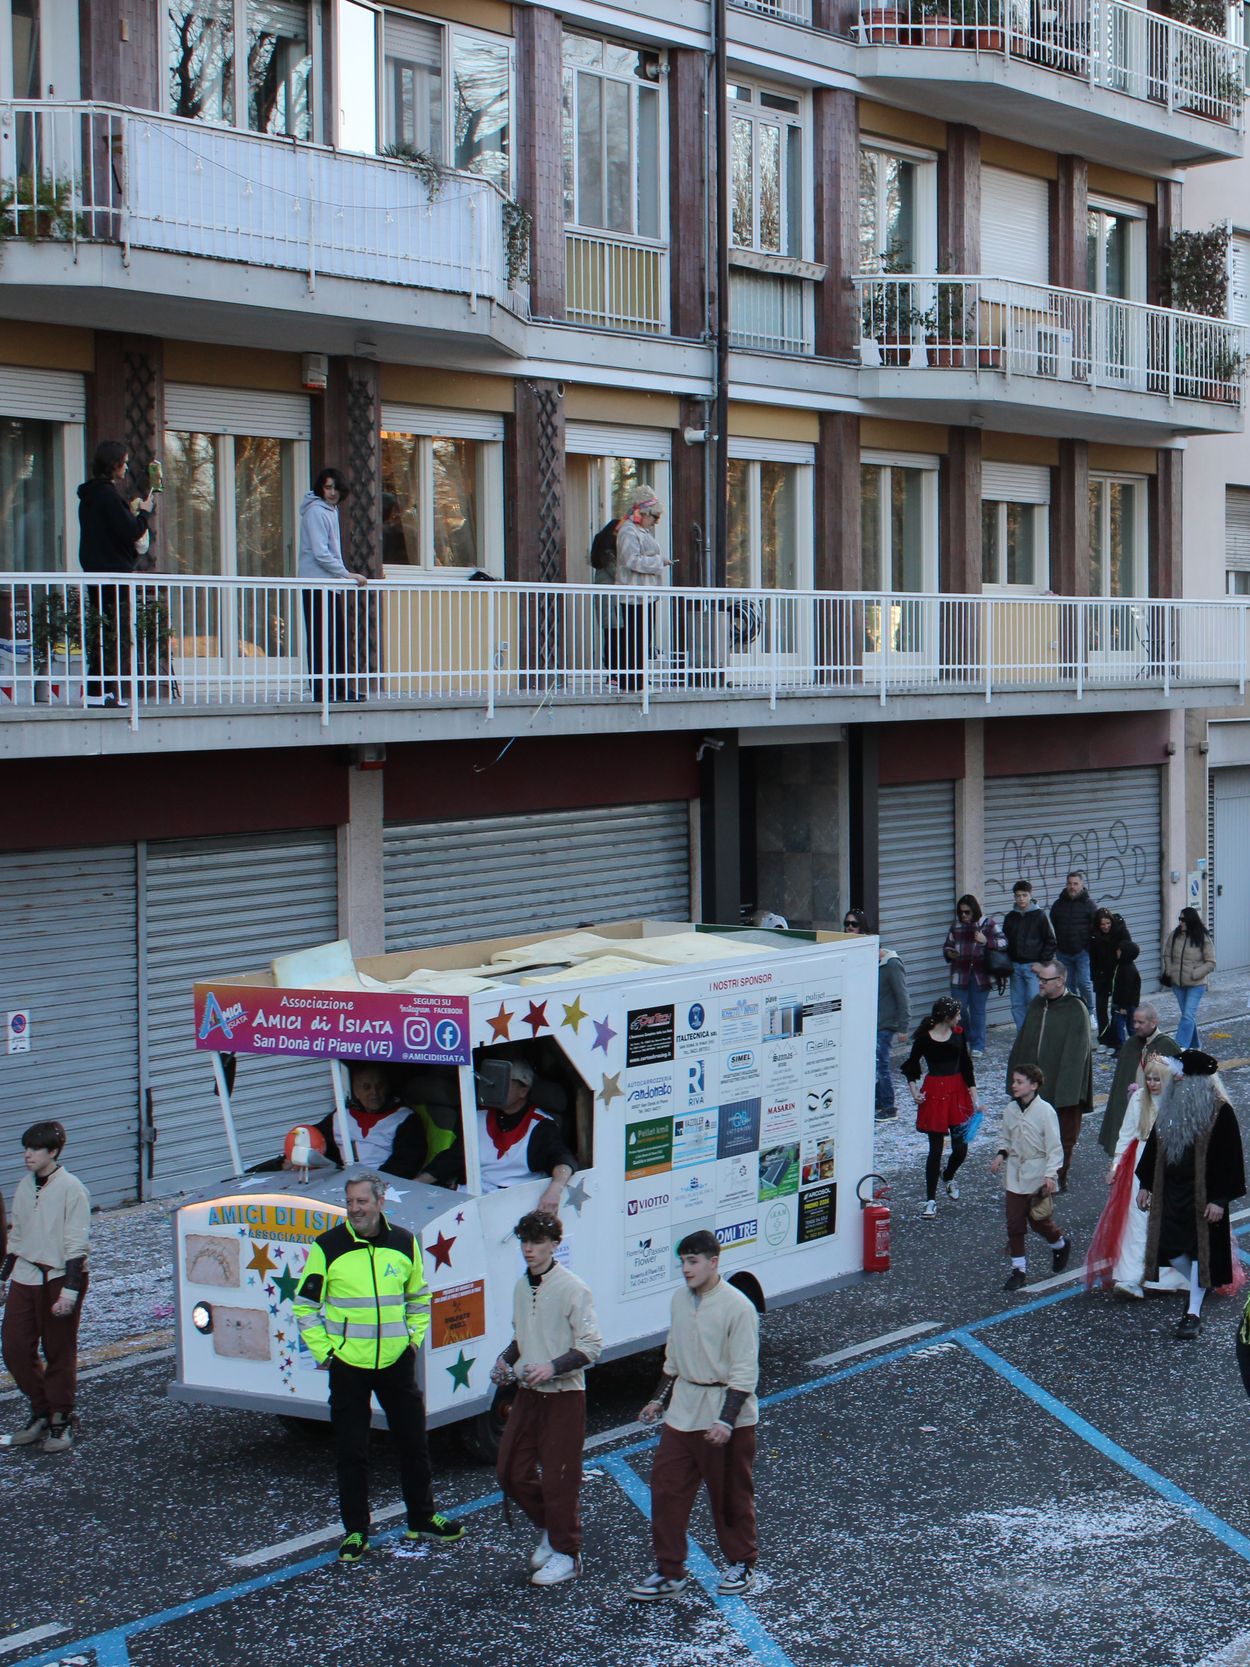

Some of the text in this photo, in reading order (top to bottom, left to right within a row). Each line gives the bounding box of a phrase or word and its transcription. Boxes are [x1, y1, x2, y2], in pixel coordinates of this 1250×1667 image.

[713, 980, 740, 991] NOSTRI
[740, 974, 773, 987] SPONSOR
[280, 996, 354, 1011] Associazione
[413, 997, 452, 1006] SEGUICI SU
[400, 1004, 464, 1016] Instagram FACEBOOK
[252, 1009, 394, 1035] AMICI di ISIATA
[676, 1031, 710, 1042] ITALTECNICA
[253, 1033, 393, 1057] San Donà di Piave (VE)
[730, 1054, 751, 1064] SIMEL
[627, 1075, 672, 1088] AUTOCARROZZERIA
[688, 1096, 704, 1106] RIVA
[767, 1102, 796, 1114] MASARIN
[638, 1126, 656, 1138] Pellet
[807, 1188, 832, 1198] ARCOSOL
[639, 1194, 670, 1209] VIOTTO
[208, 1204, 348, 1231] AMICI DI ISIA
[249, 1229, 317, 1244] ASSOCIAZIO
[716, 1221, 757, 1244] OMI TRE
[634, 1255, 657, 1268] Flower
